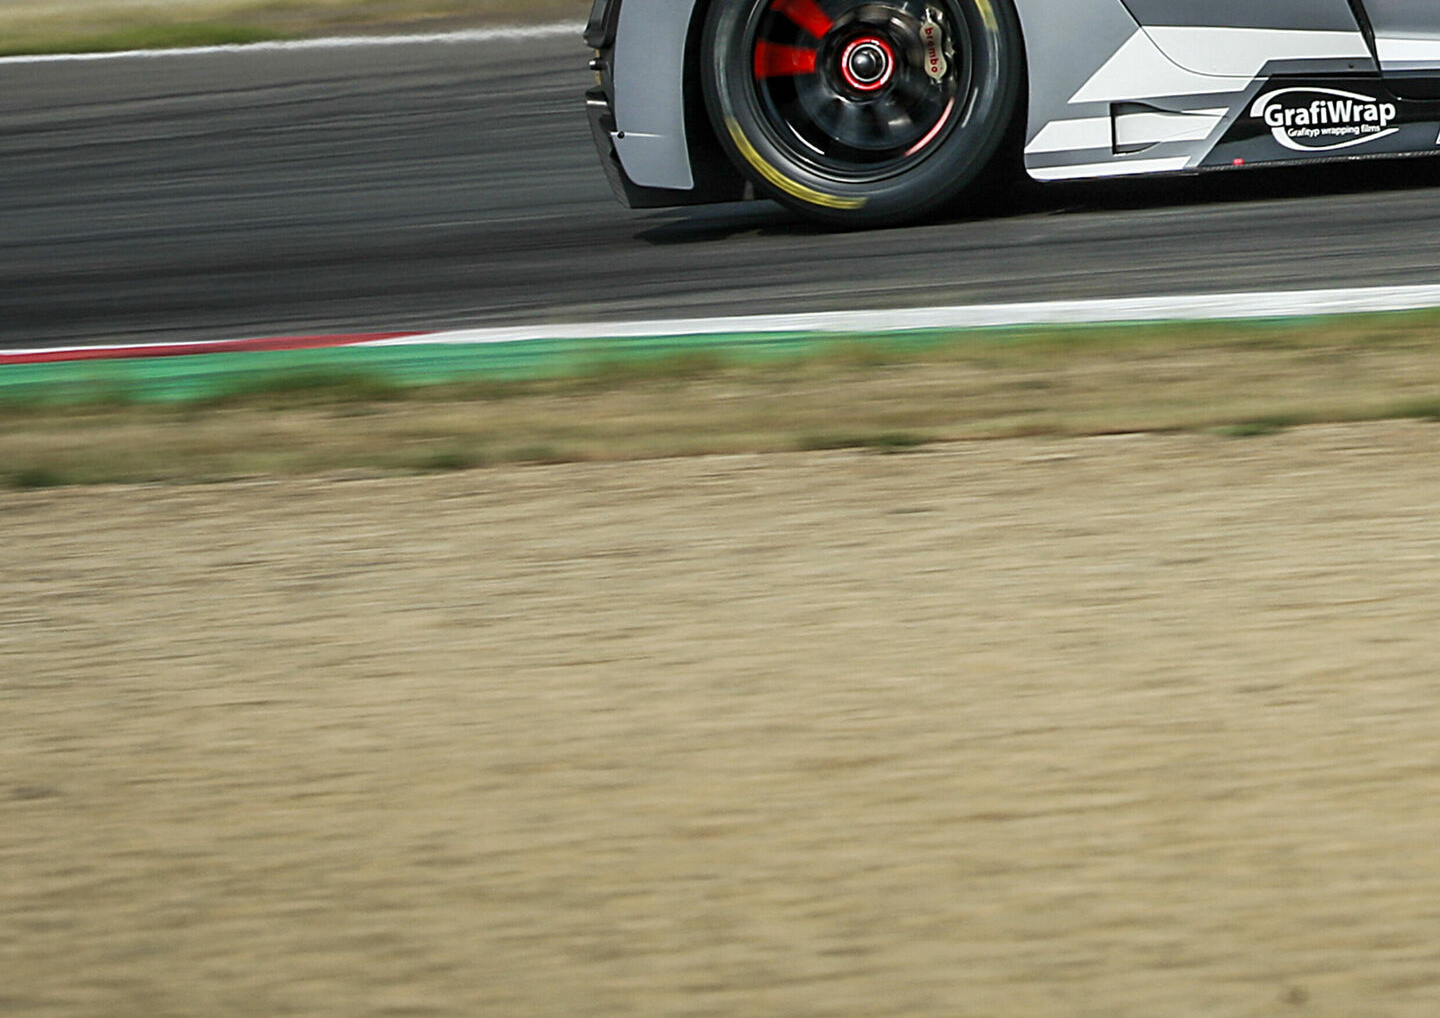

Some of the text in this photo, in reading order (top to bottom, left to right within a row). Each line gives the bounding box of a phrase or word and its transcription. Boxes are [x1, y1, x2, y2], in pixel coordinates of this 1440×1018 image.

[925, 27, 939, 73] brembo
[1264, 100, 1396, 127] GrafiWrap
[1321, 125, 1360, 136] wrapping
[1361, 124, 1381, 133] films
